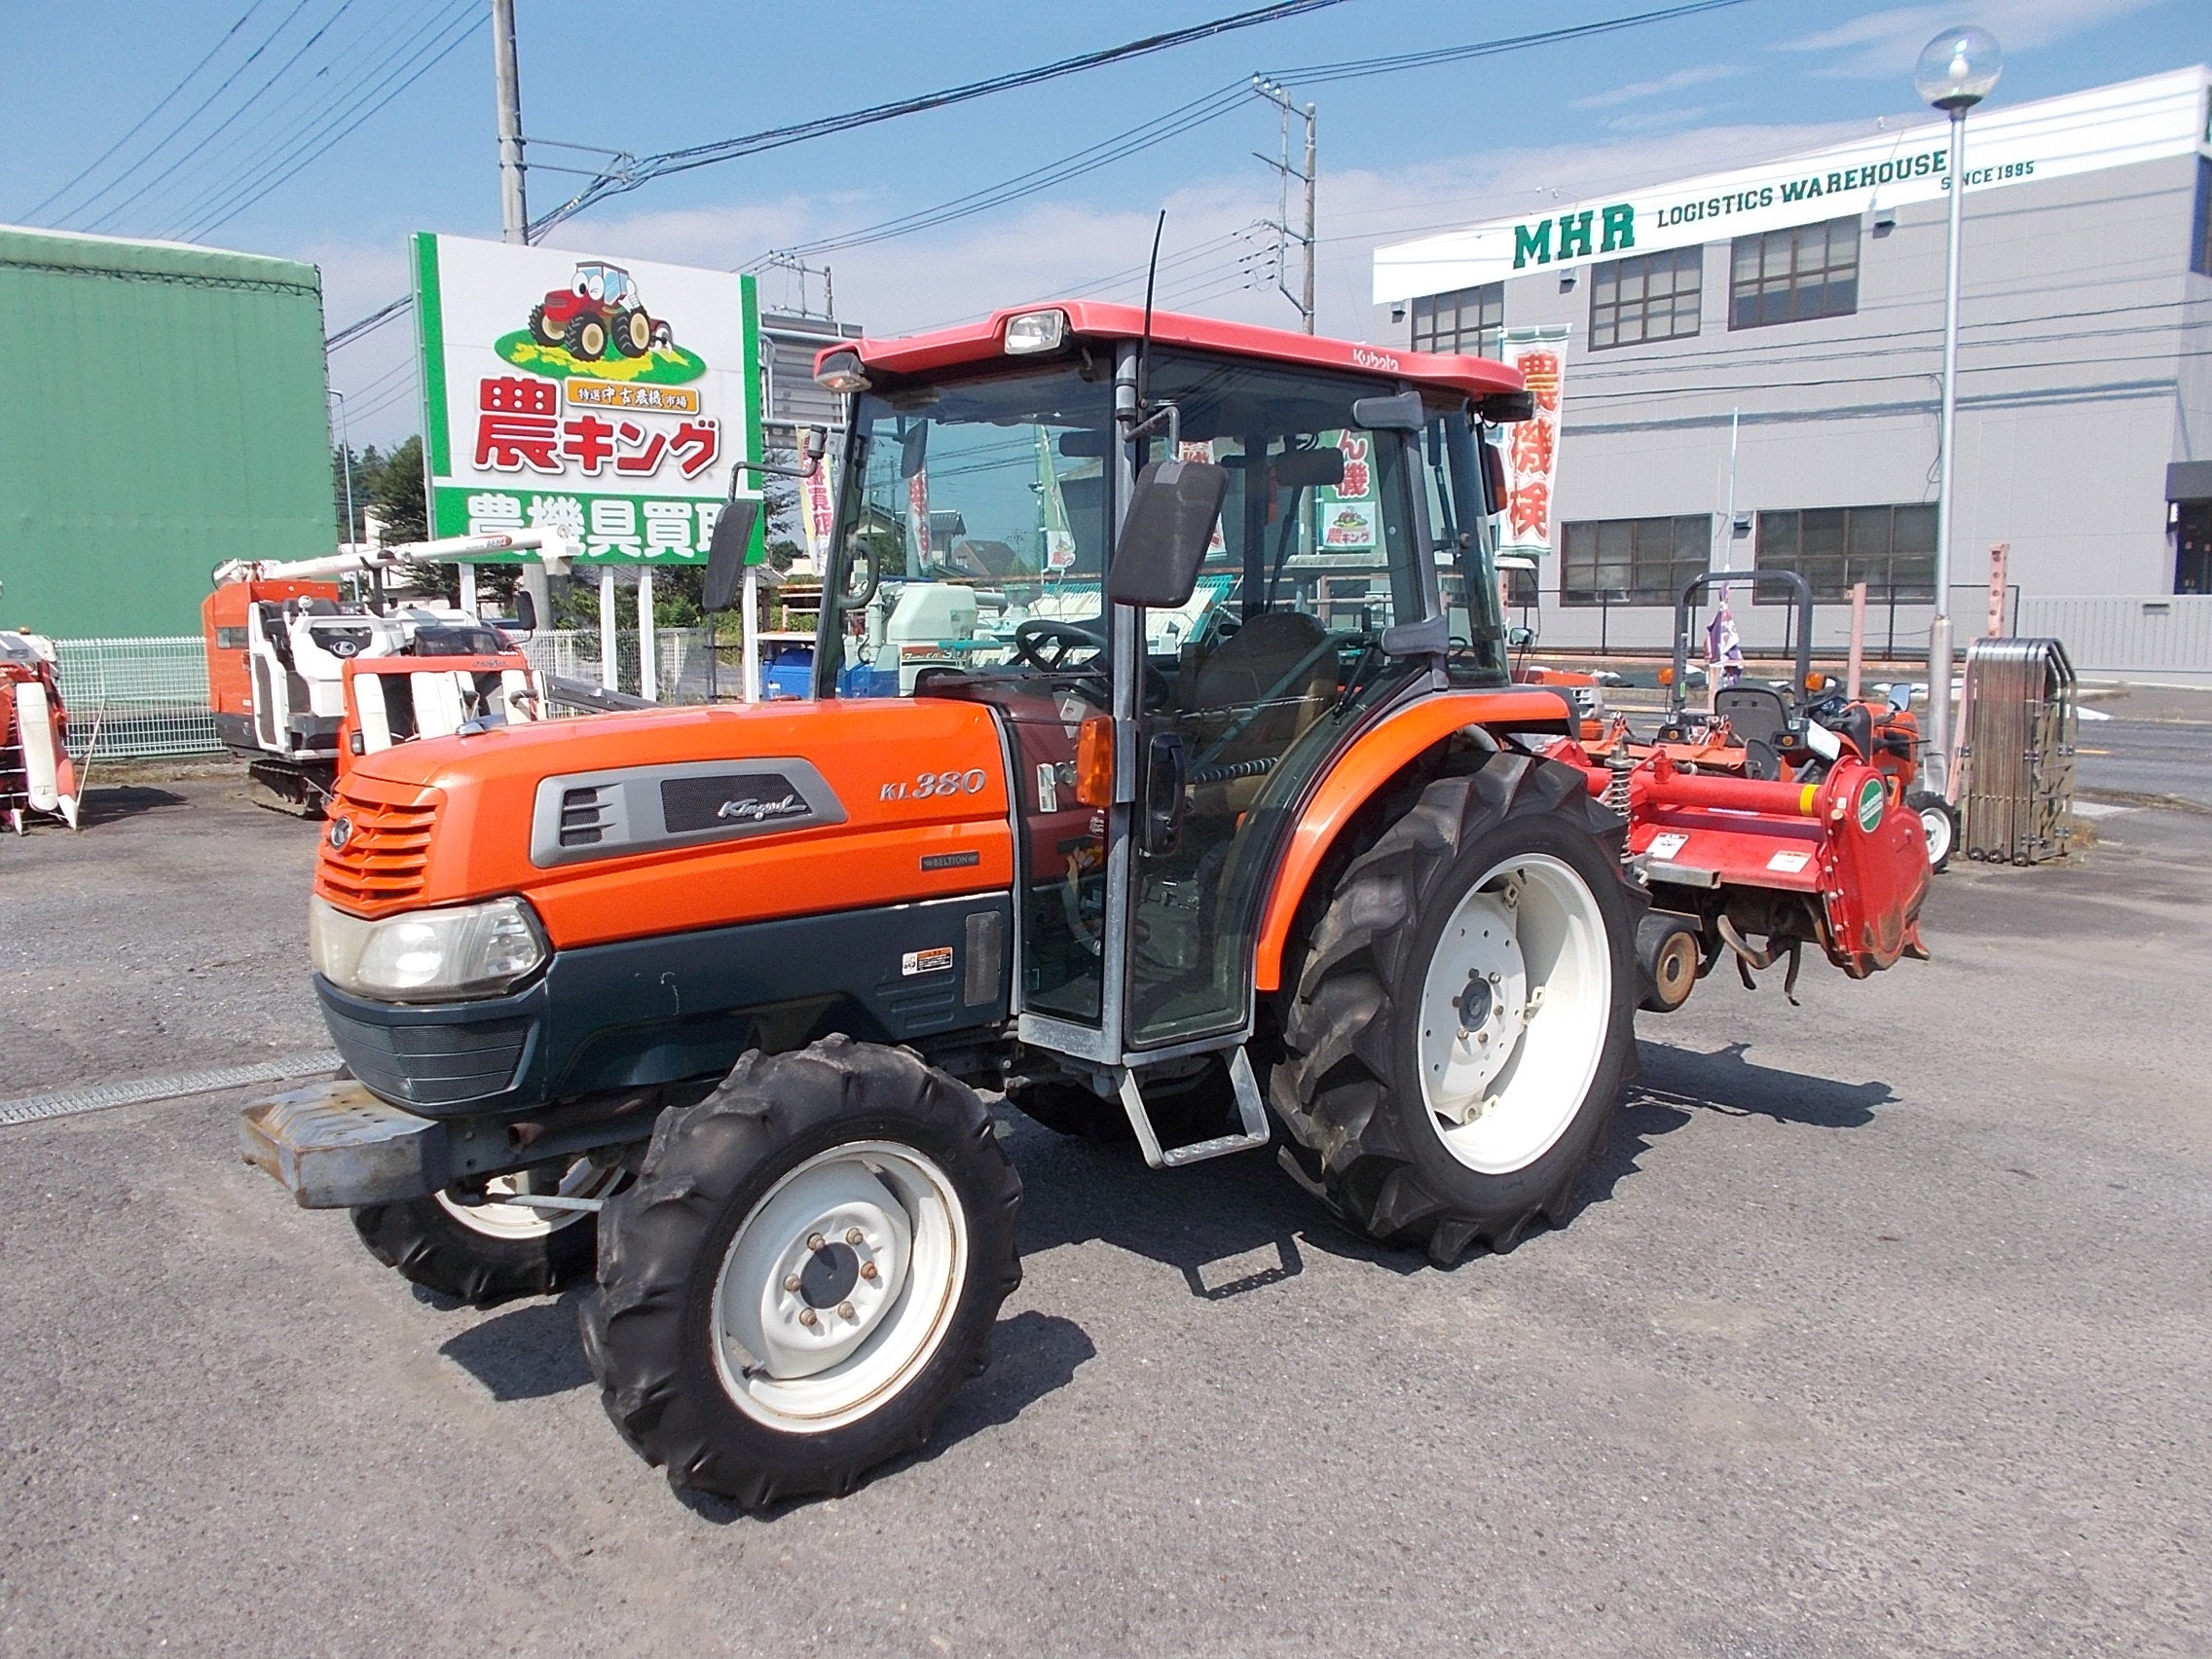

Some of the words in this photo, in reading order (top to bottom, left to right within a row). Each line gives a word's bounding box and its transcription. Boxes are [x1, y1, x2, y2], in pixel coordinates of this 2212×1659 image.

[1657, 187, 1773, 229] LOGISTICS
[1781, 149, 1948, 203] WAREHOUSE
[1940, 167, 1994, 191] SNCE
[1997, 161, 2035, 181] 1995
[1513, 203, 1635, 270] MHR
[1352, 348, 1399, 371] Kubota
[474, 376, 717, 475] 農キング
[933, 854, 969, 867] BELTION
